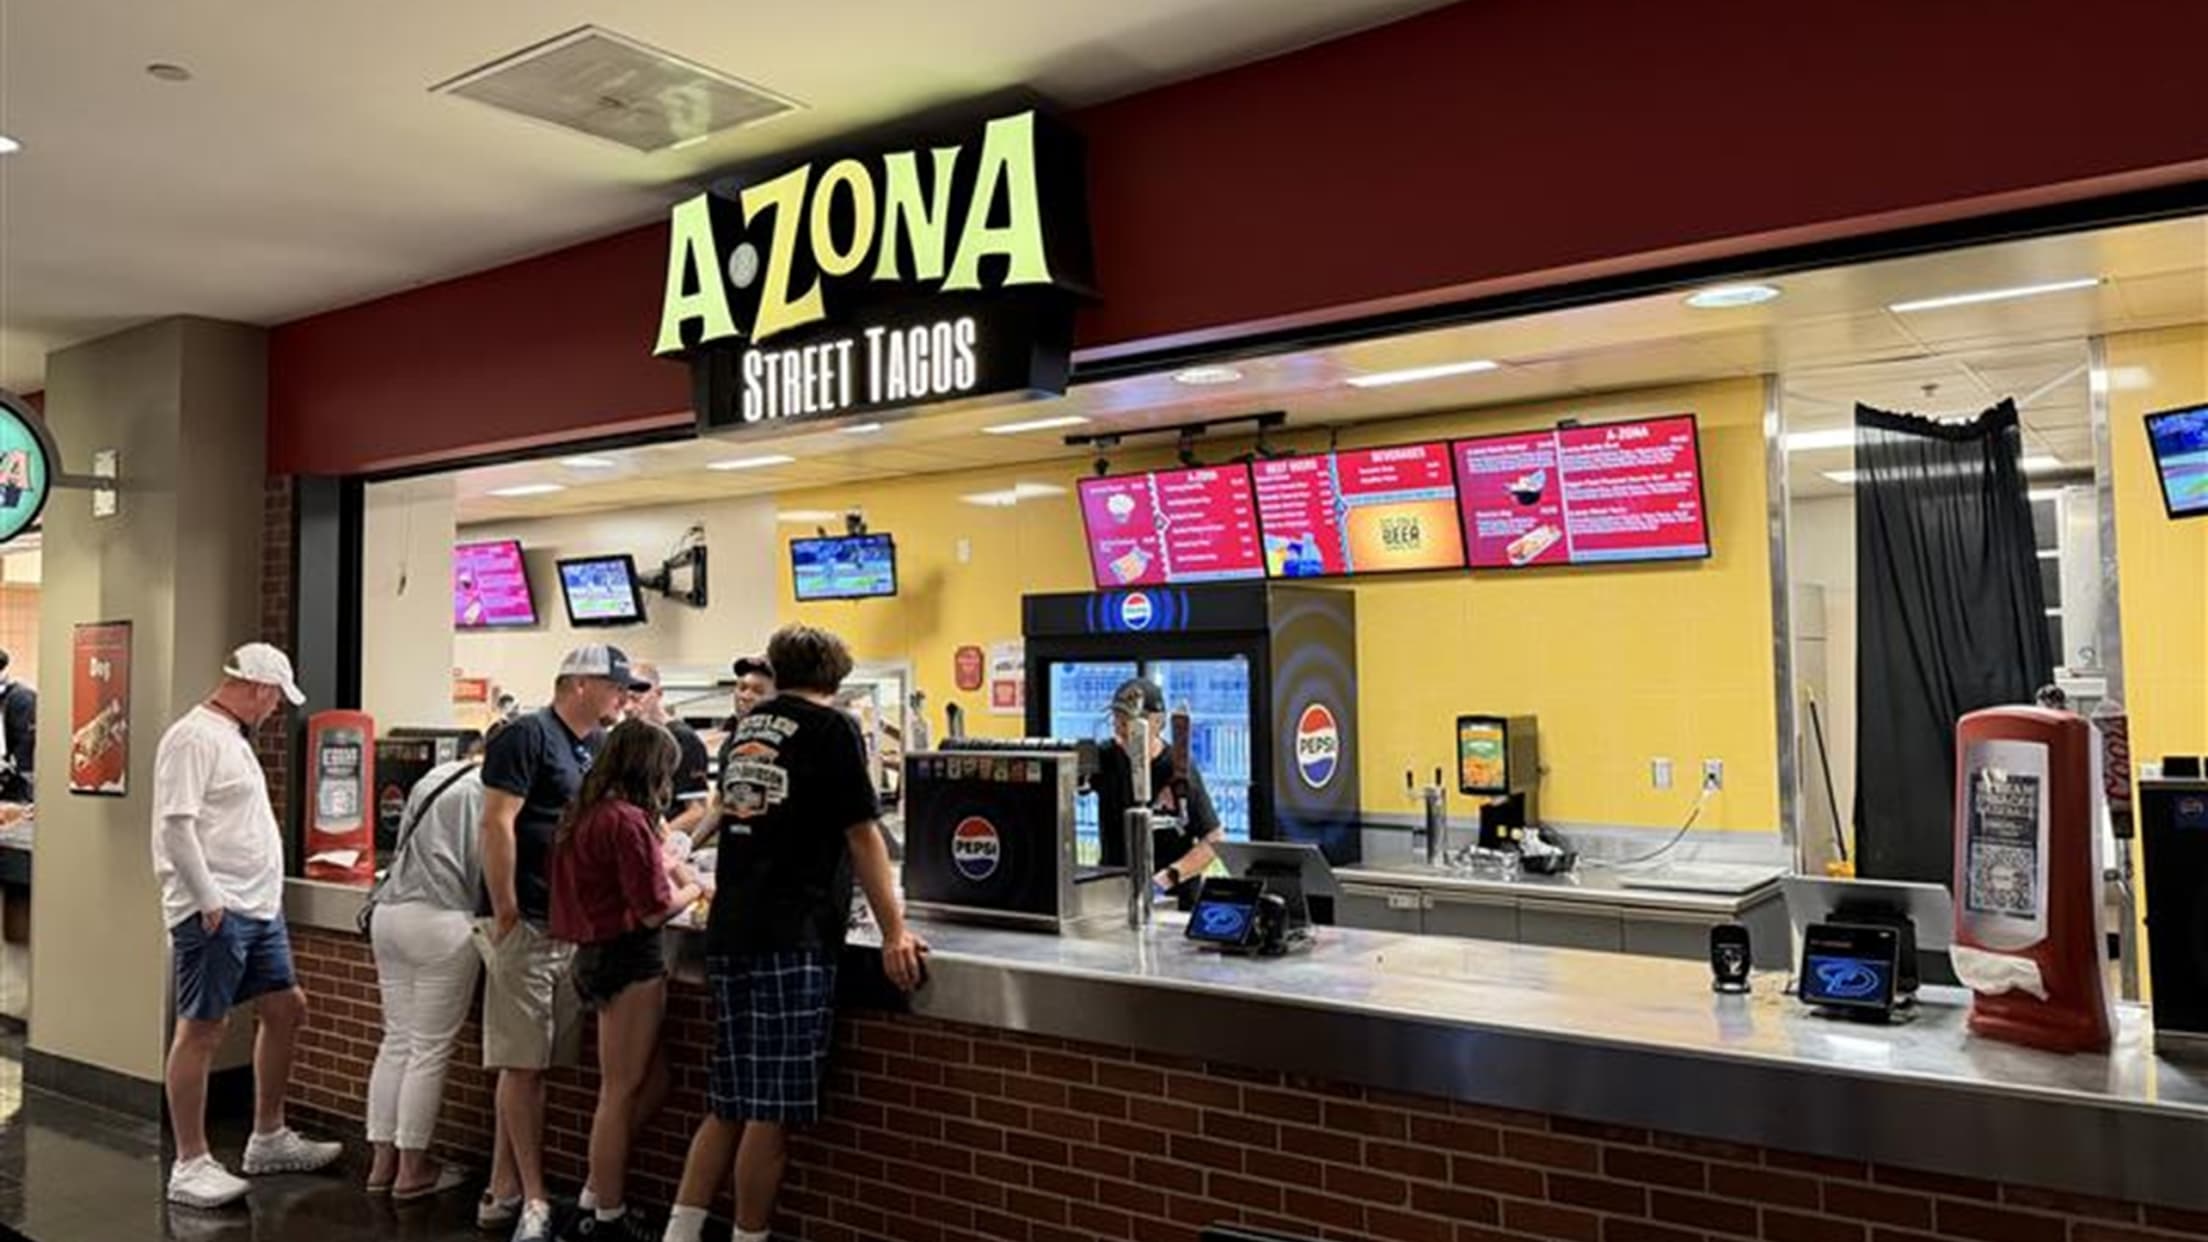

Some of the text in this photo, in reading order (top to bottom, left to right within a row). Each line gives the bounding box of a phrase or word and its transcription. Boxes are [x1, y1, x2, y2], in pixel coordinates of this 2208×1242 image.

[743, 317, 976, 422] STREET TACOS
[1300, 736, 1338, 754] PEPSI
[955, 840, 997, 856] PEPSI
